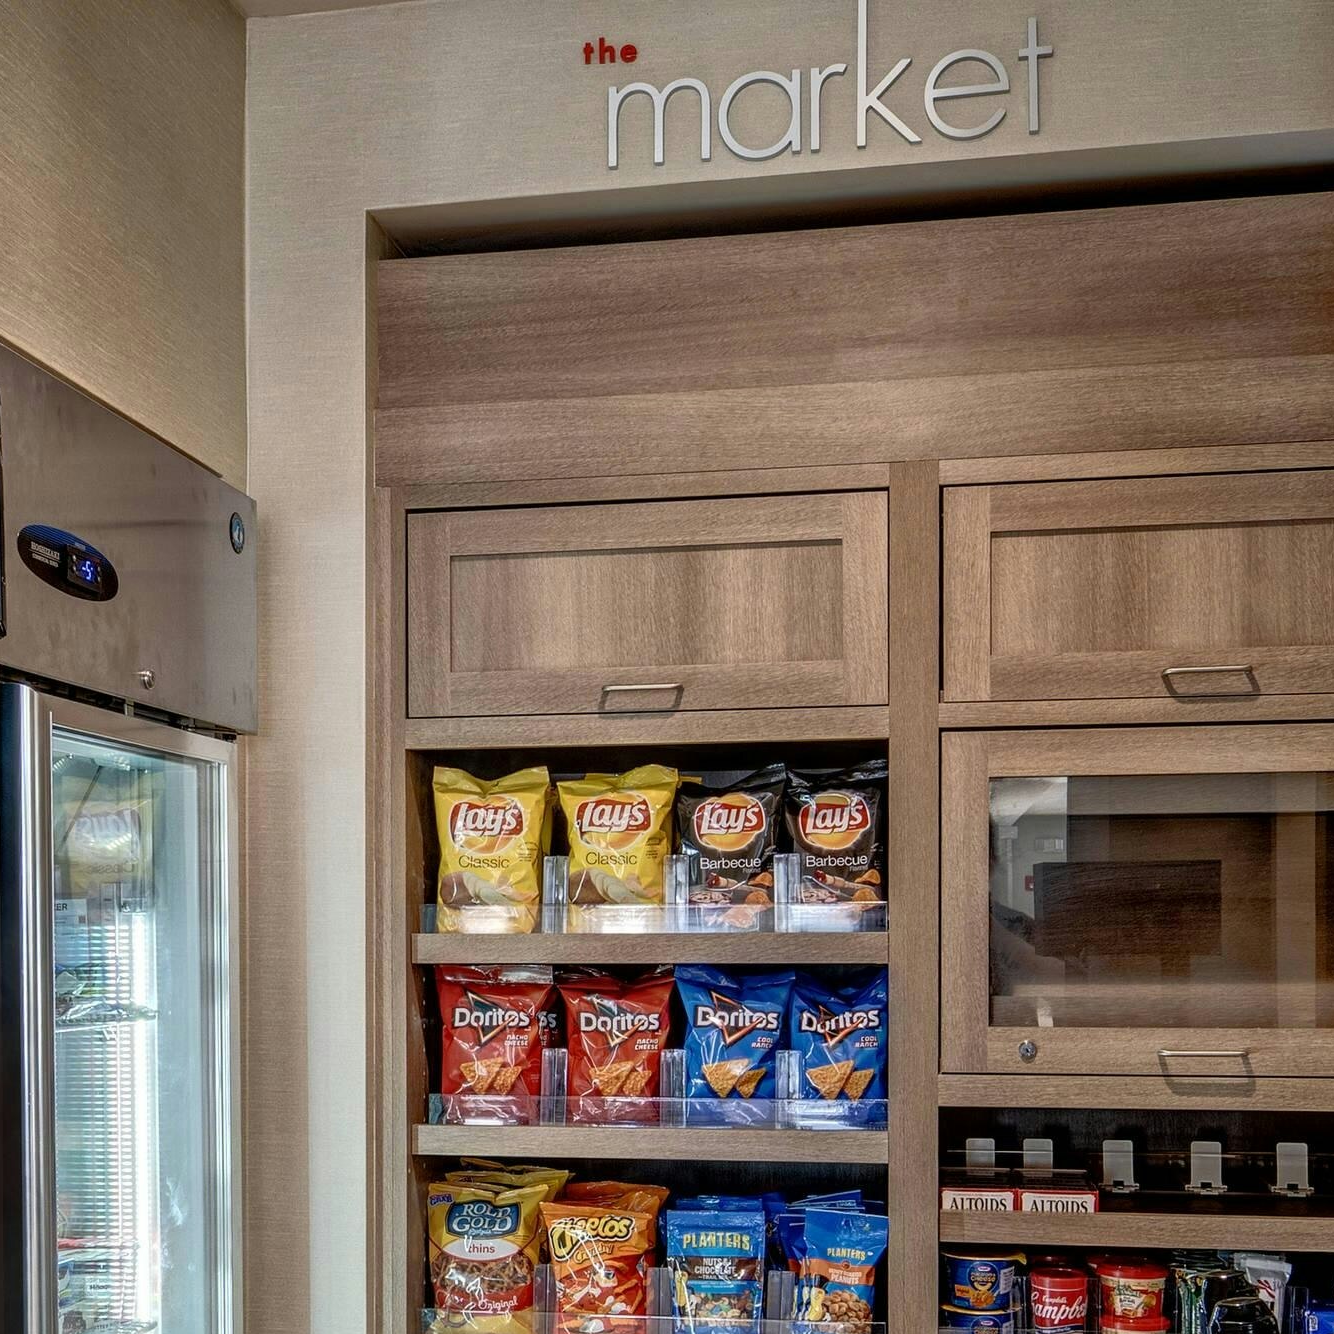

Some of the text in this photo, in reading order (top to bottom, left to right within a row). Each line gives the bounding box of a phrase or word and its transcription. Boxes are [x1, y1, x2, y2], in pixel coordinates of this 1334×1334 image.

[583, 38, 638, 64] the
[608, 0, 1053, 170] market
[454, 803, 518, 836] Lay's
[583, 801, 647, 832] Lay's
[701, 802, 759, 835] Lay's
[806, 801, 864, 834] Lay's
[459, 855, 510, 869] Classic
[586, 852, 637, 865] Classic
[700, 858, 761, 870] Barbecue
[806, 855, 868, 867] Barbecue
[454, 1007, 530, 1028] Doritos
[580, 1012, 660, 1033] Doritos
[696, 1007, 778, 1030] Doritos
[801, 1009, 879, 1032] Doritos
[462, 1203, 510, 1217] ROLD
[453, 1215, 513, 1232] GOLD
[467, 1244, 495, 1254] thins
[683, 1232, 750, 1250] PLANTERS
[703, 1258, 724, 1266] NUTS
[827, 1248, 865, 1260] PLANTERS
[831, 1274, 859, 1284] PEANUTS
[479, 1296, 518, 1311] Original
